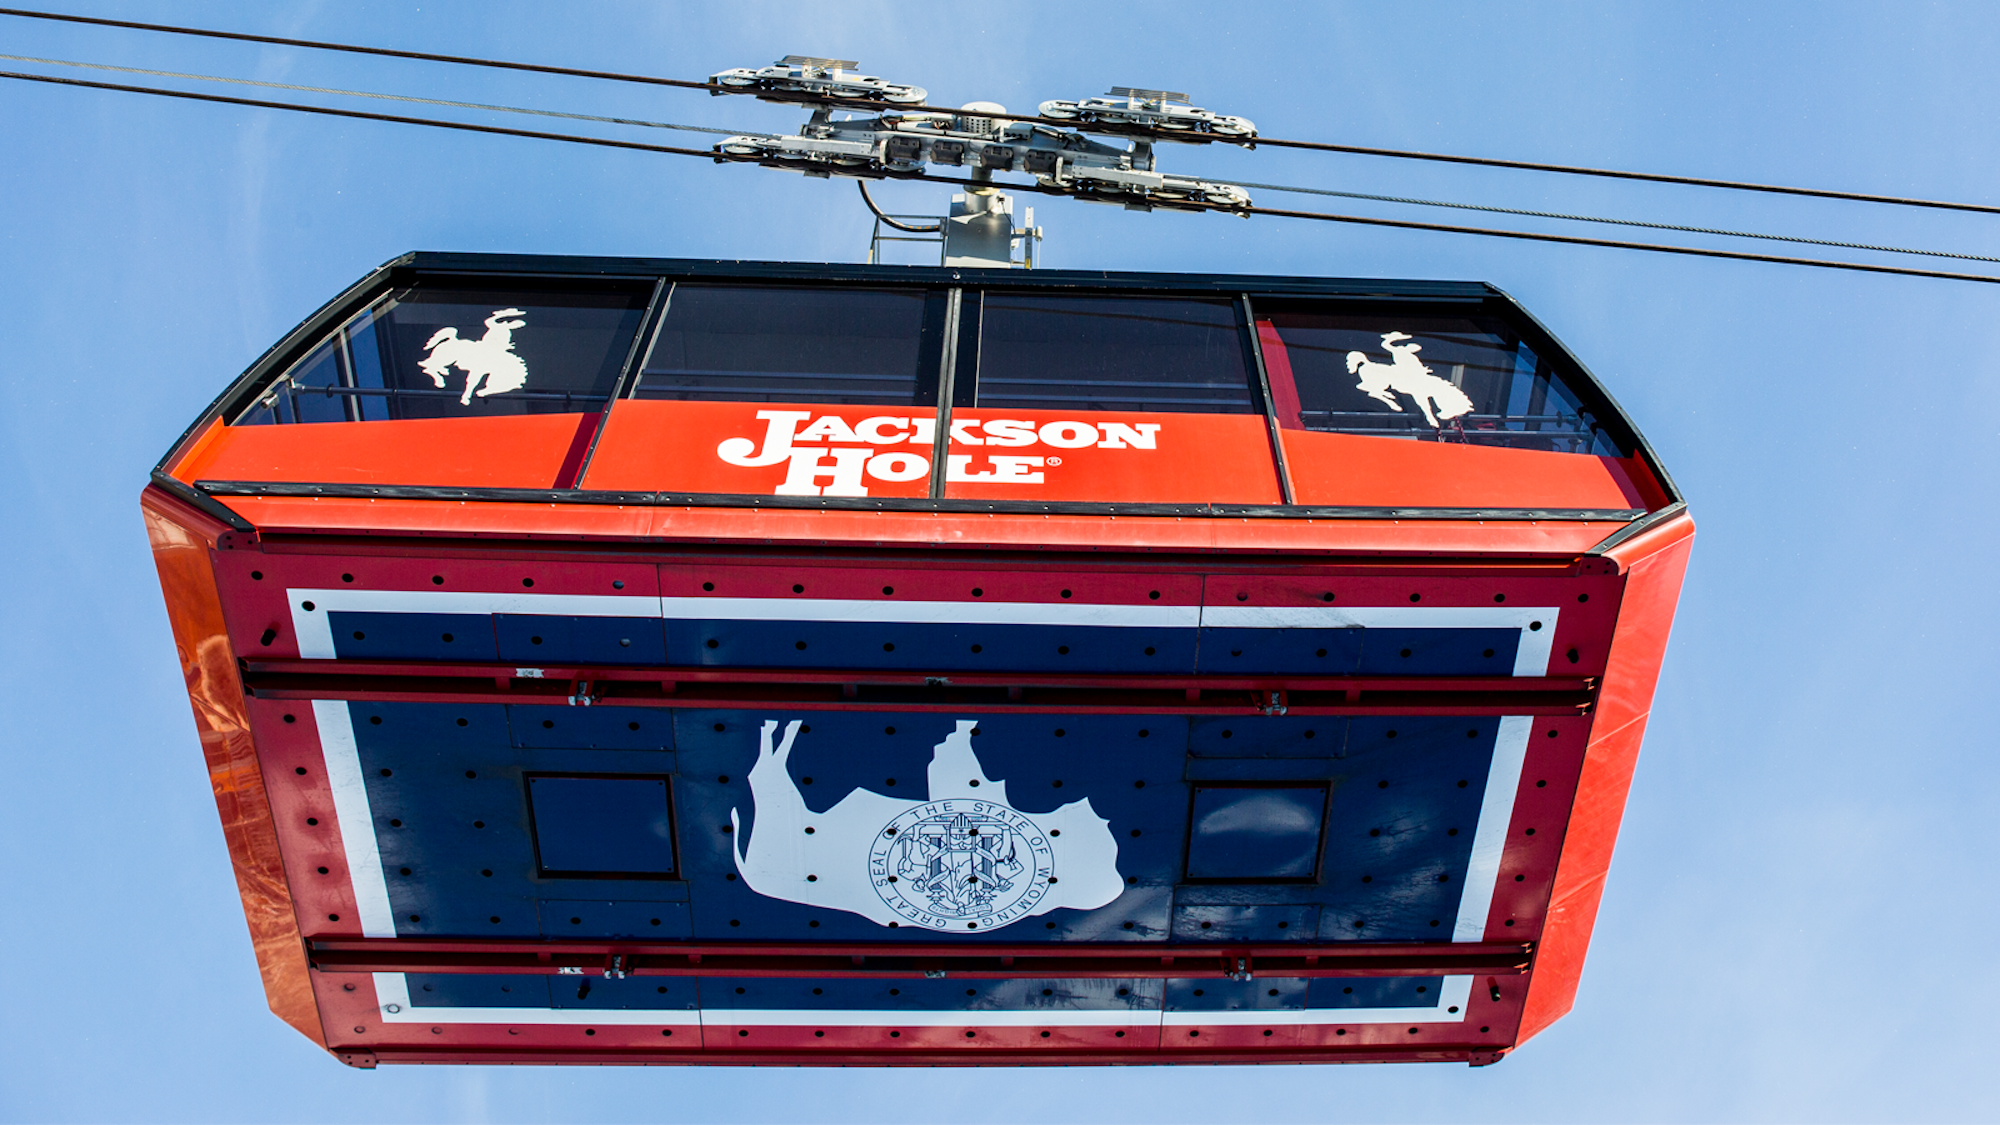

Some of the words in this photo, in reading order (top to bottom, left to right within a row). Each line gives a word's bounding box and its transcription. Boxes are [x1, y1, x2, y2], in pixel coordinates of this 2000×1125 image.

[717, 410, 1161, 467] JACKSON
[910, 802, 954, 820] THE
[973, 802, 1029, 831] STATE
[1030, 836, 1049, 855] OF
[872, 850, 888, 888] SEAL
[886, 895, 947, 928] GREAT
[982, 867, 1050, 926] WYOMING
